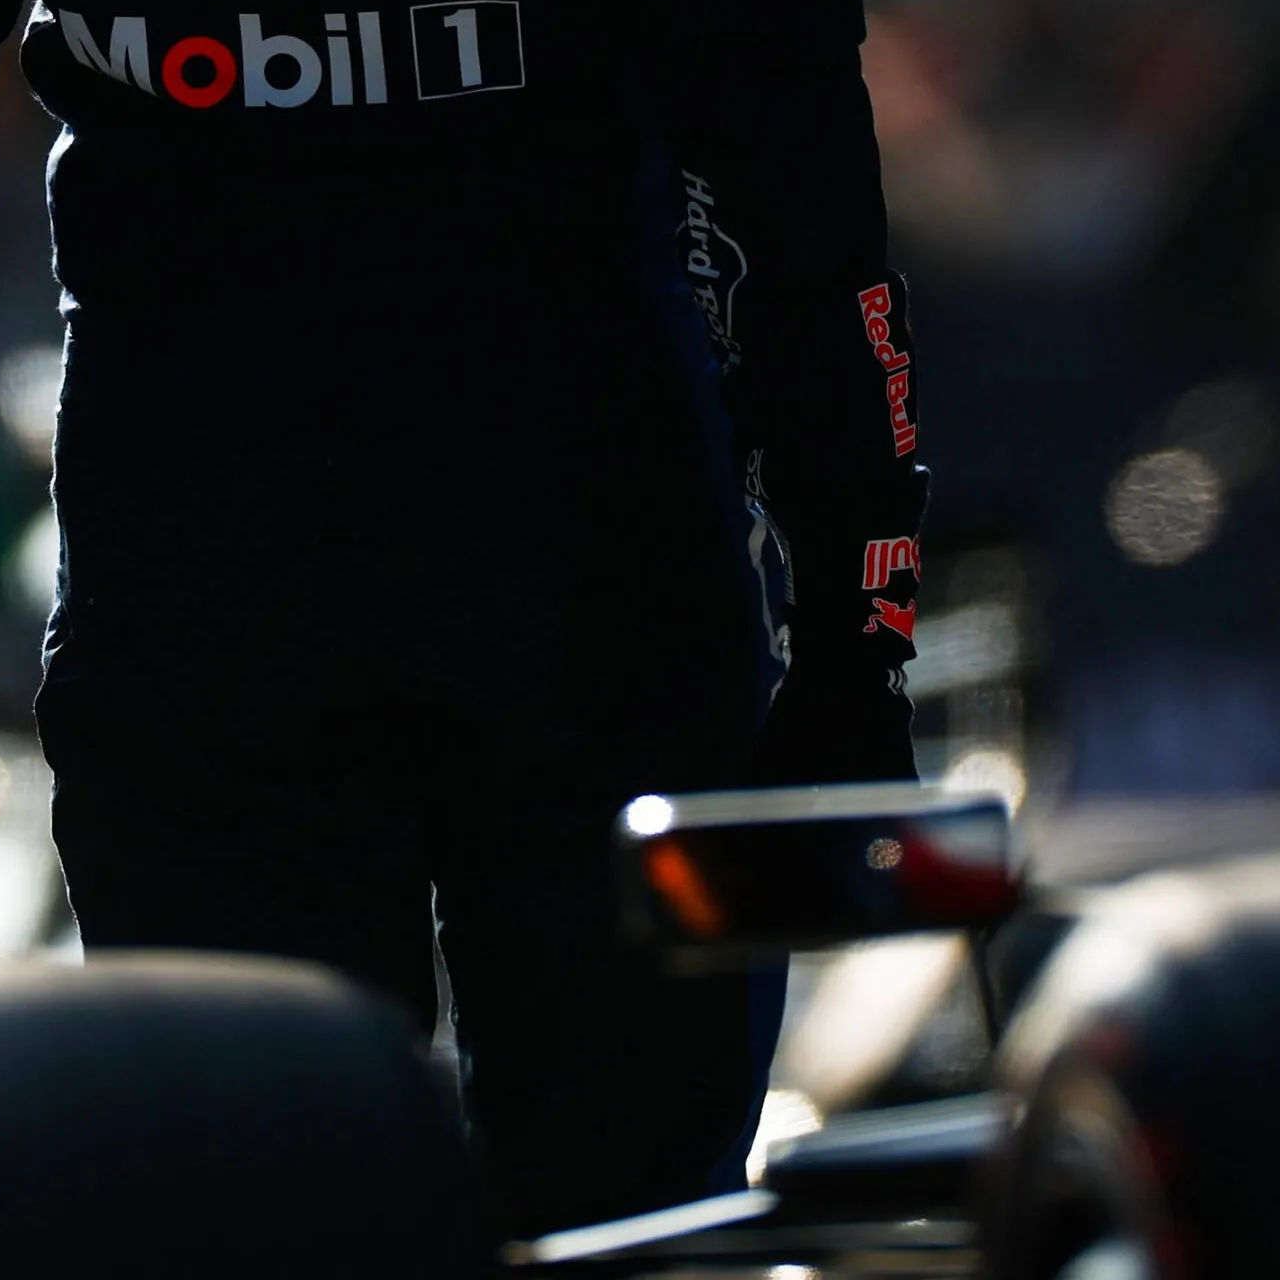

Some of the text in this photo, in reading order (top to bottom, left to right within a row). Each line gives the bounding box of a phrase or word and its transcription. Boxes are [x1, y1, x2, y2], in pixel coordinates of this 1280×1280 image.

[59, 7, 483, 109] Mobil 1
[680, 169, 721, 280] Hard
[857, 283, 917, 458] Red Bull
